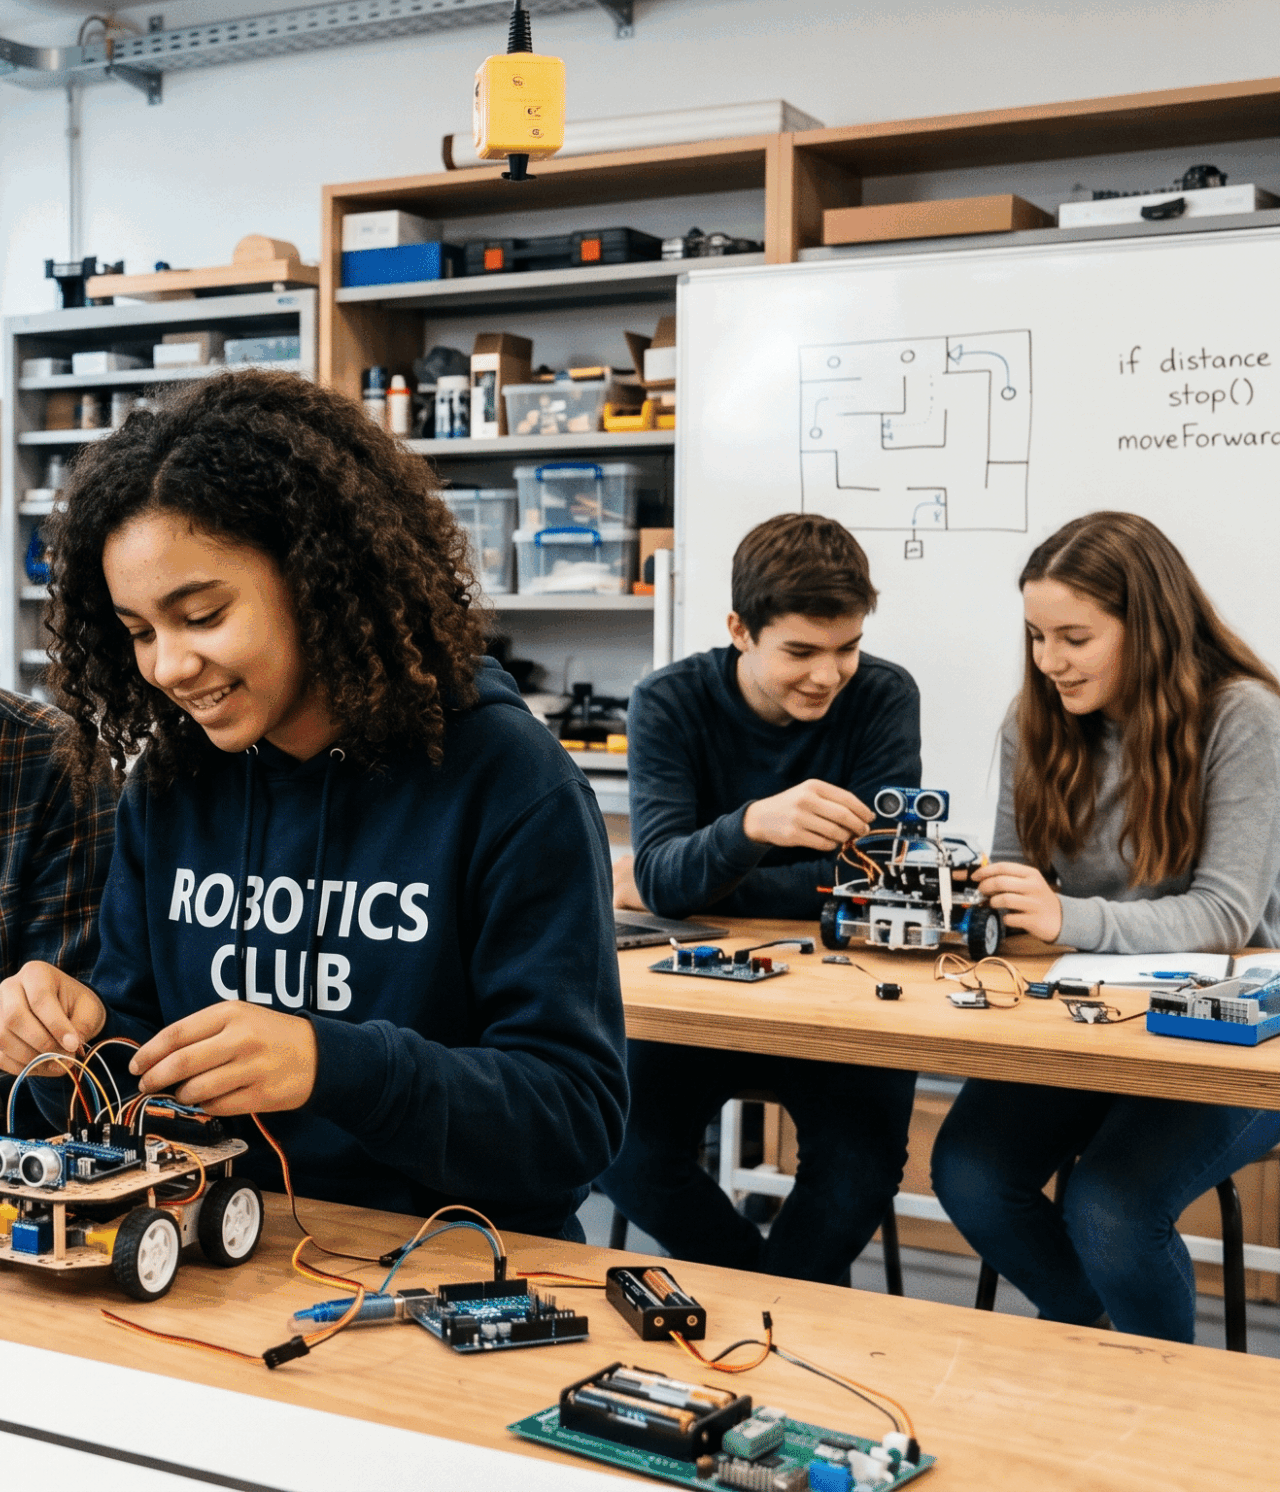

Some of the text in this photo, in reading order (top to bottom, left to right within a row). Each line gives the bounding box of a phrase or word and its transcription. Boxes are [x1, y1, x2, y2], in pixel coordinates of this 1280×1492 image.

[1119, 345, 1271, 374] if distance
[1168, 377, 1254, 413] stop()
[168, 867, 429, 943] ROBOTICS
[210, 943, 352, 1011] CLUB
